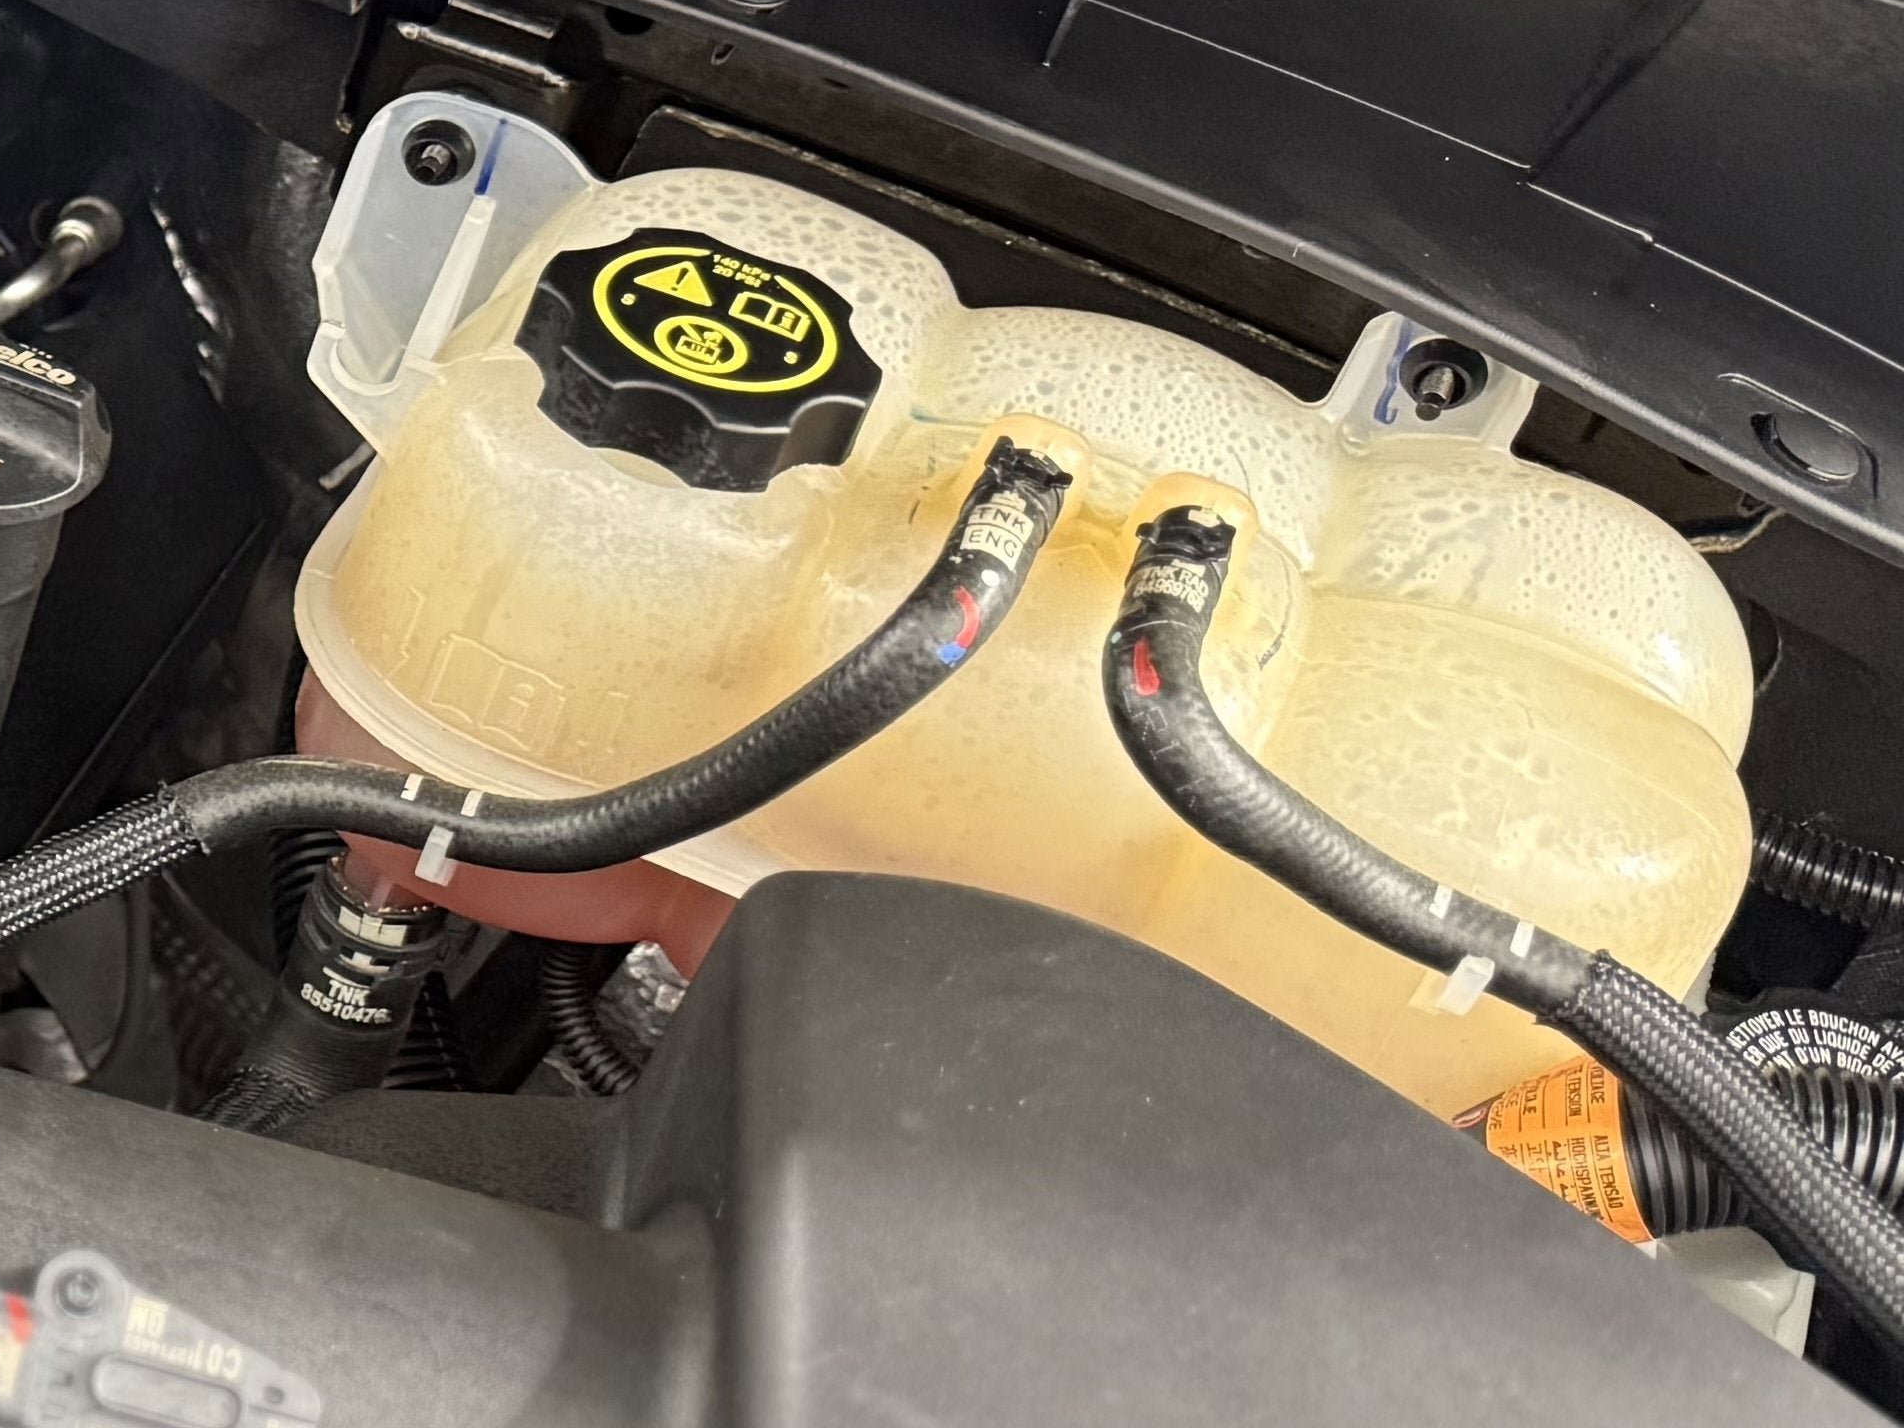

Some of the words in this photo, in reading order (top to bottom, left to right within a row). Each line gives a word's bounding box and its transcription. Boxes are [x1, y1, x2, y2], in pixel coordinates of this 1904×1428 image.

[712, 264, 734, 278] 20
[976, 505, 1026, 534] TNK
[968, 528, 1019, 558] ENG
[1179, 570, 1209, 598] RAD
[328, 979, 371, 1006] TNK
[1784, 1009, 1805, 1025] LE
[1808, 1009, 1880, 1047] BOUCHON
[1758, 1031, 1789, 1054] QUE
[1788, 1028, 1810, 1044] DU
[1813, 1029, 1872, 1060] LIQUIDE
[1872, 1053, 1895, 1074] DE
[1794, 1046, 1832, 1066] D'UN
[1593, 1134, 1612, 1161] ALTA
